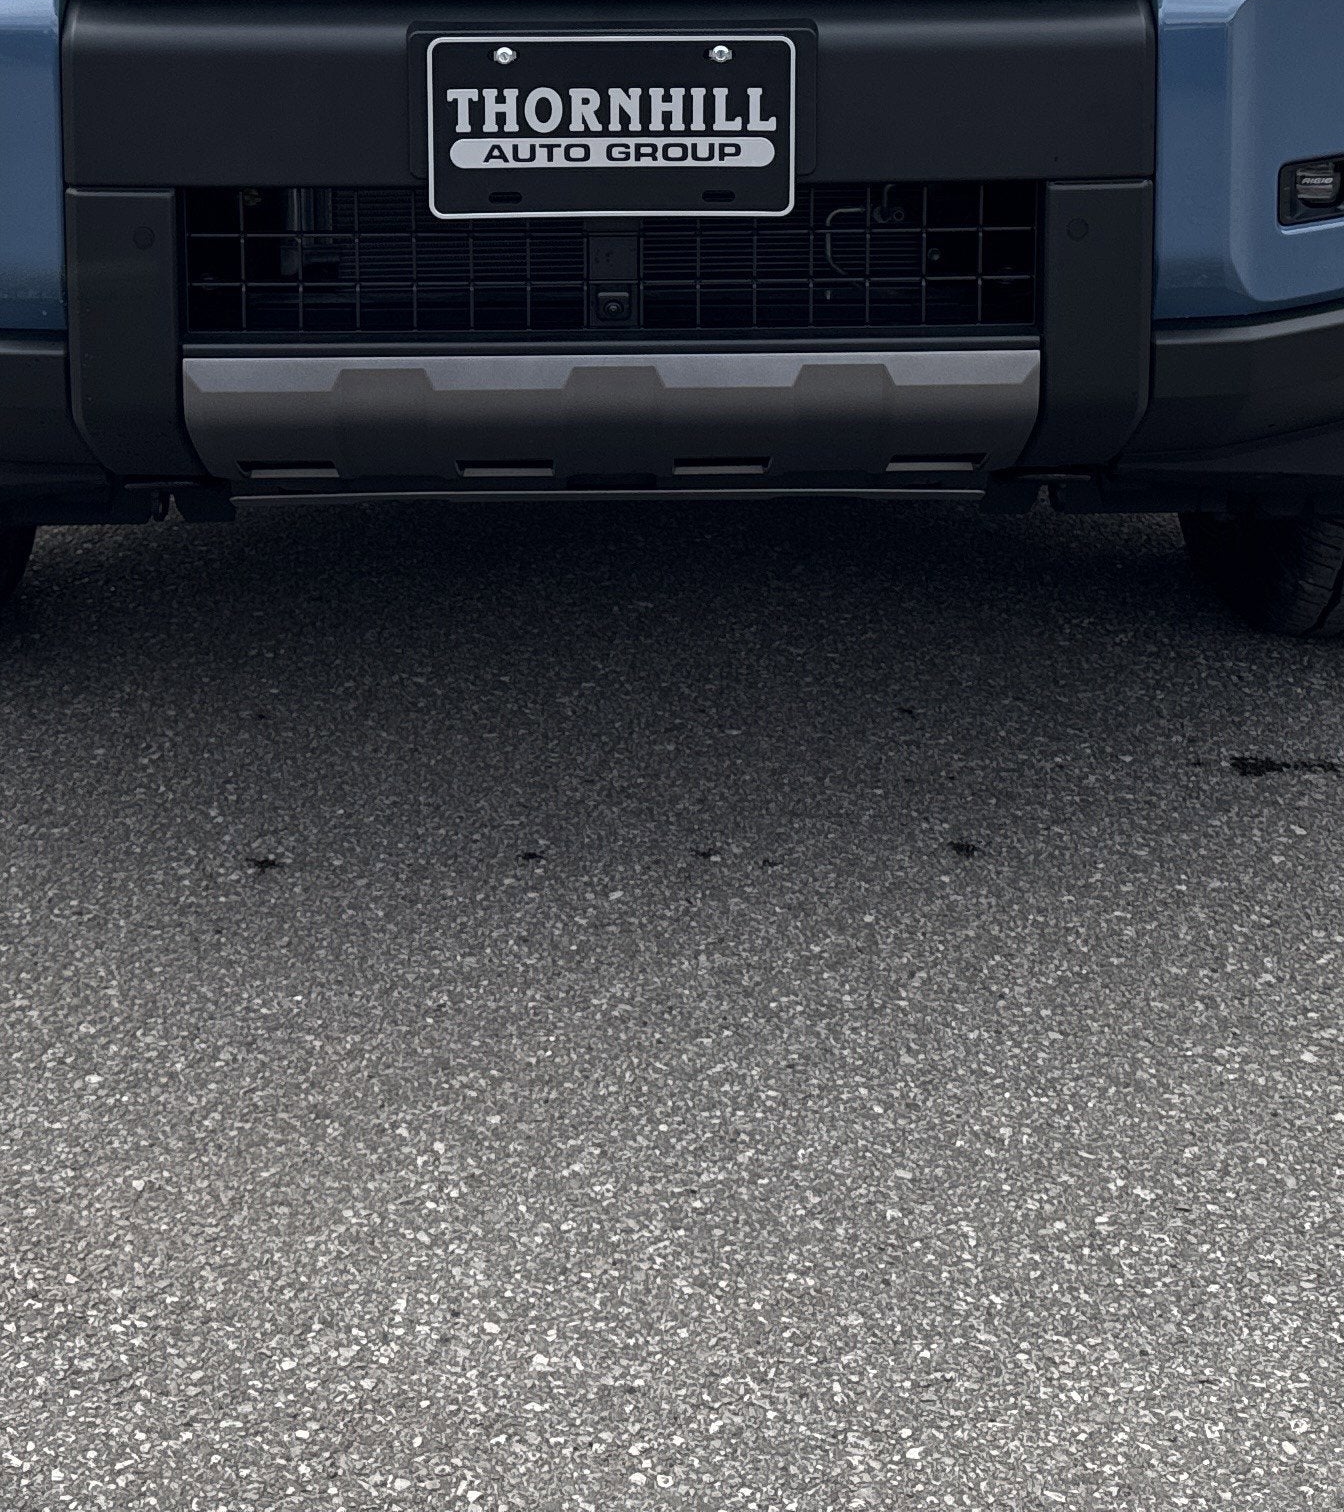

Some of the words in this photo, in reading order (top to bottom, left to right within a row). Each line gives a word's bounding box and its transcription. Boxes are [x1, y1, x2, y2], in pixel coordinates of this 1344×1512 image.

[446, 87, 777, 133] THORNHILL
[483, 144, 591, 163] AUTO
[605, 142, 742, 162] GROUP
